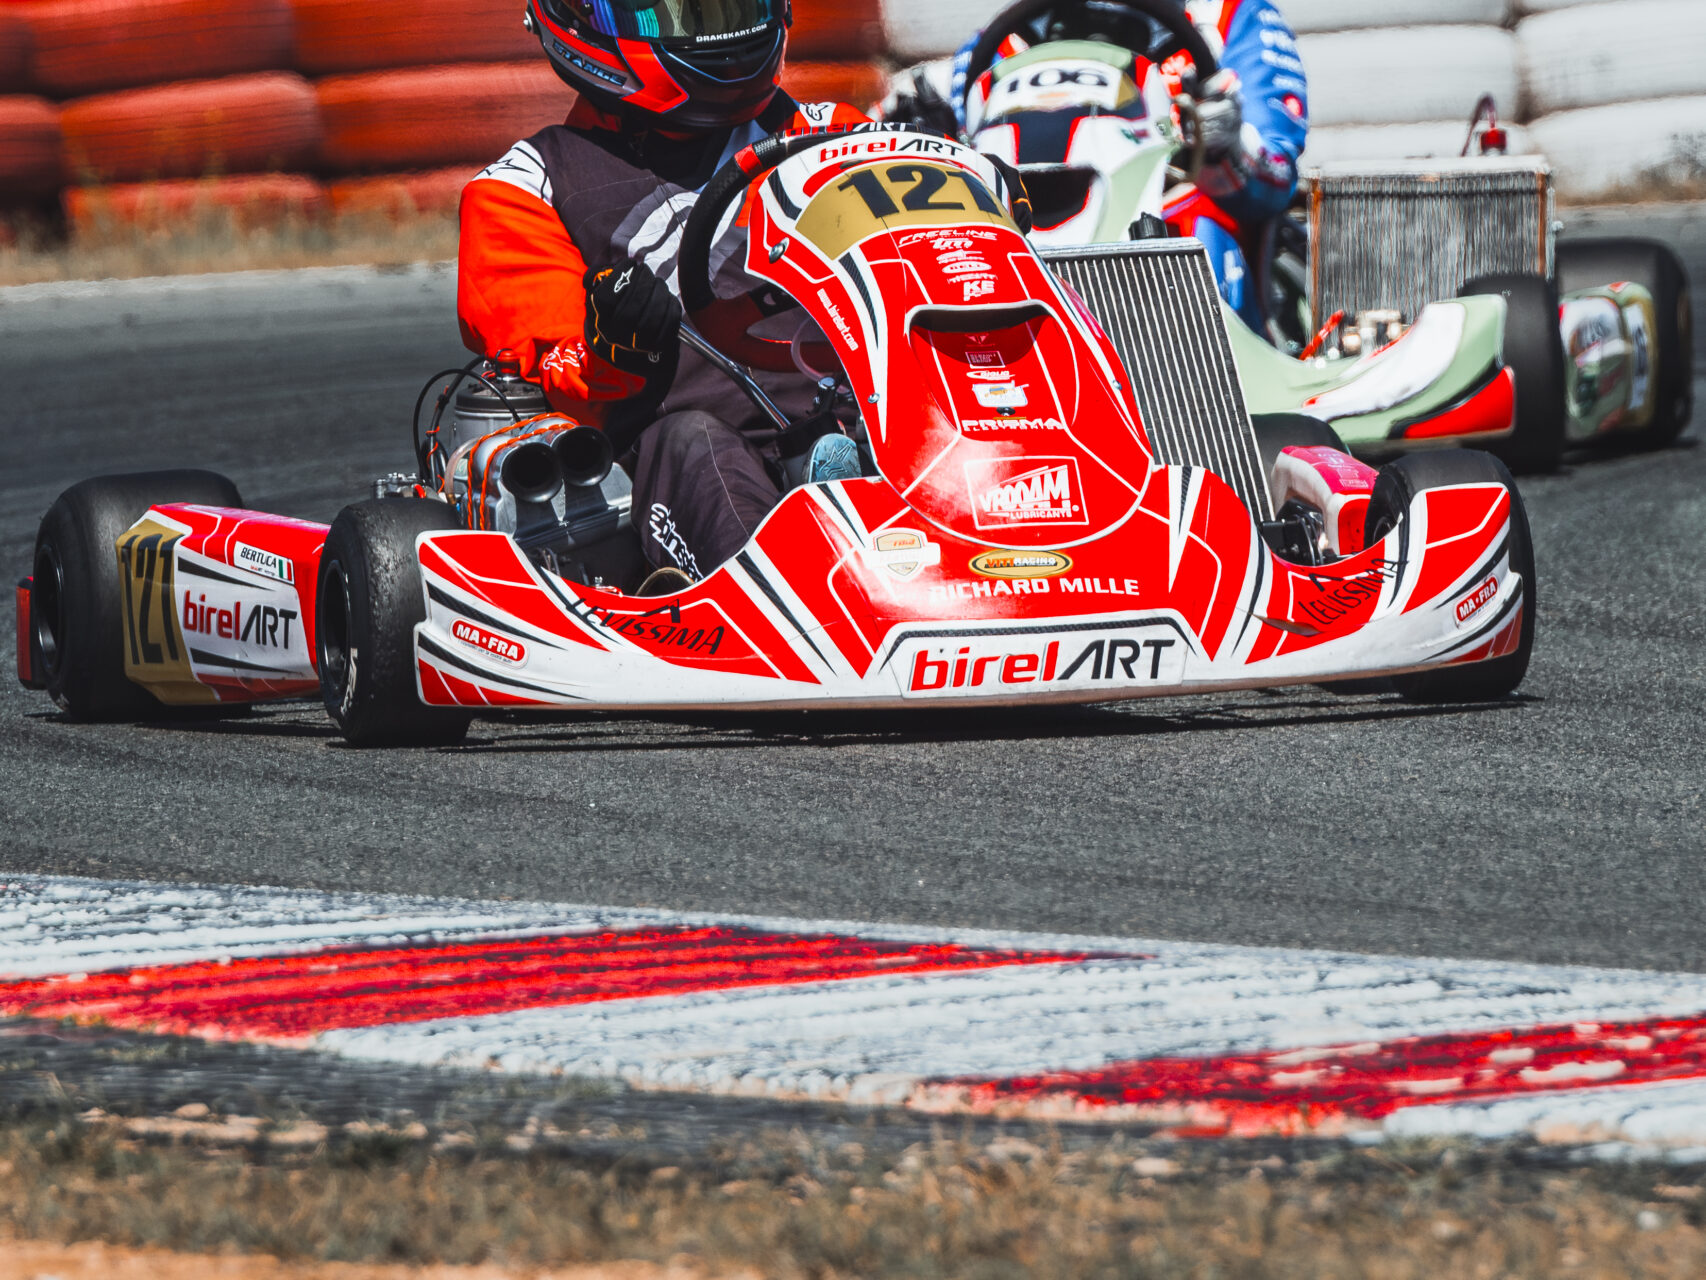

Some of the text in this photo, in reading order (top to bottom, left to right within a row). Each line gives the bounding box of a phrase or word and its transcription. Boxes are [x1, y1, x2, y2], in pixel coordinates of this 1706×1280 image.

[695, 22, 768, 43] DRAKEKART.COM
[819, 137, 963, 163] birelART
[838, 164, 1003, 220] 121
[121, 533, 186, 666] 121
[929, 577, 1140, 602] RICHARD MILLE
[183, 589, 298, 650] birelART
[908, 638, 1176, 692] birelART
